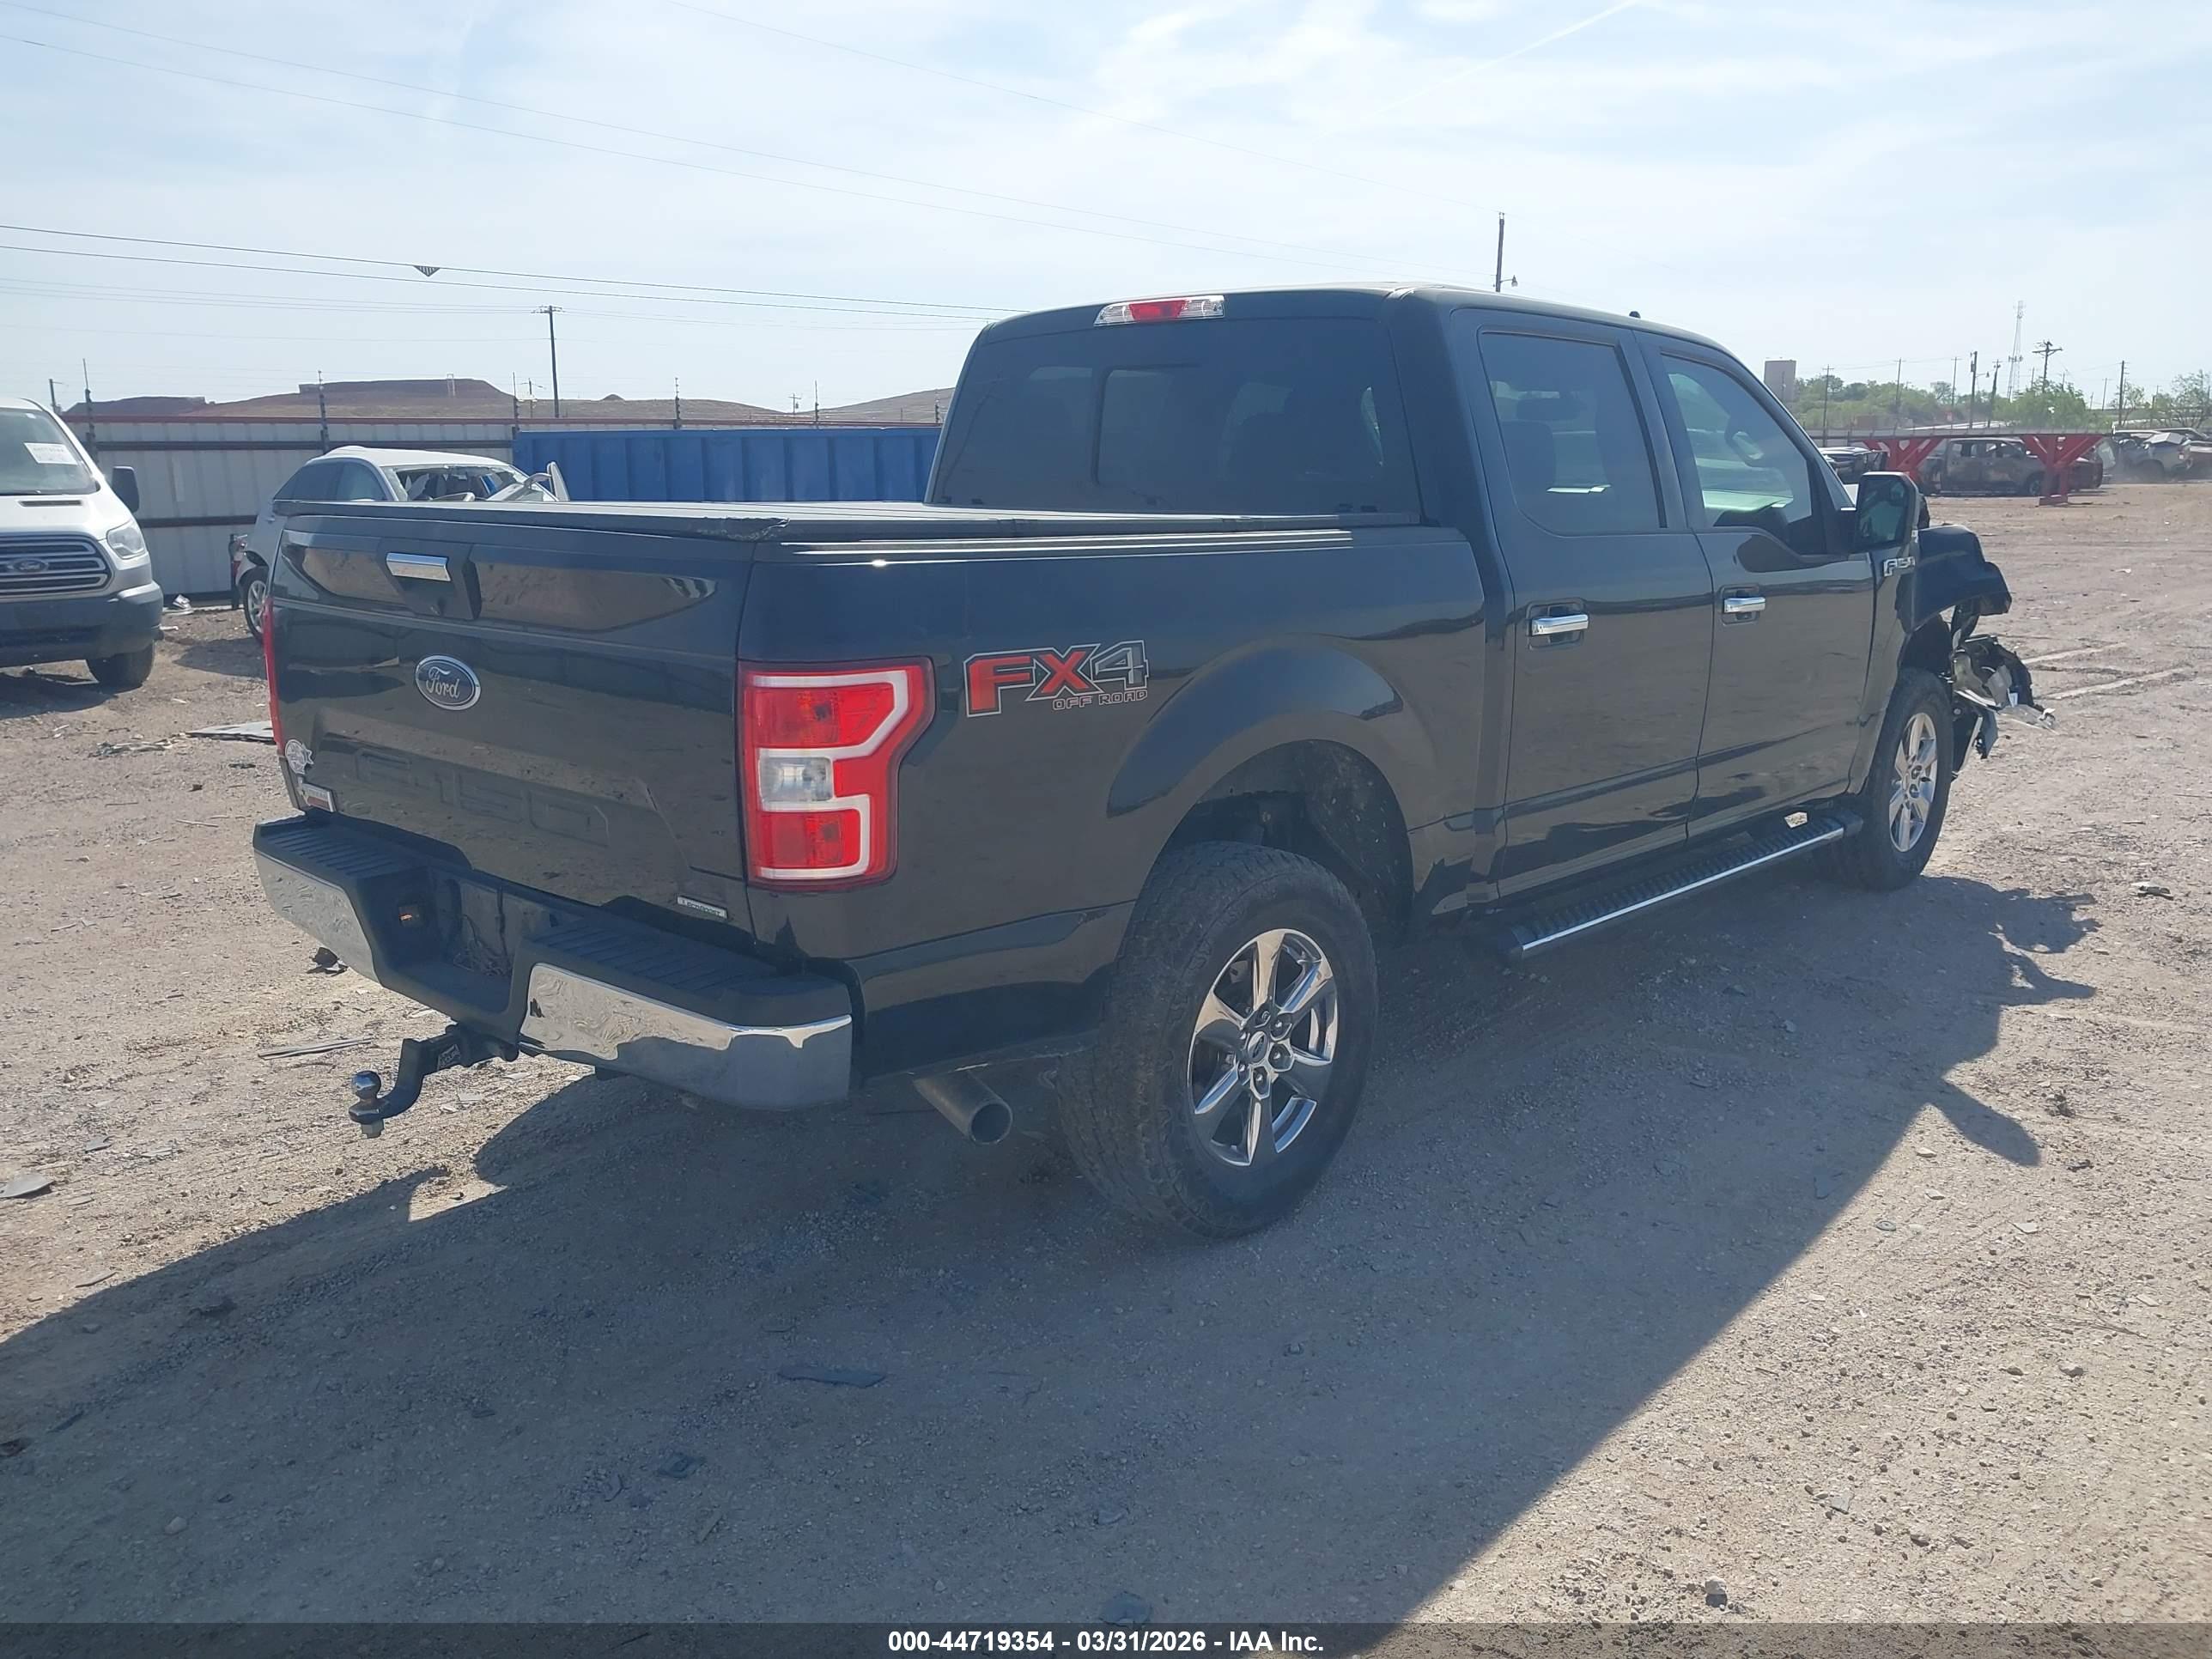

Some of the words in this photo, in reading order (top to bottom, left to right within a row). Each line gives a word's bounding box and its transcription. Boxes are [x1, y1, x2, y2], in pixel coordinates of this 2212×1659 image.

[426, 666, 459, 698] Ford
[963, 640, 1150, 718] FX4
[1052, 696, 1092, 711] OFF
[1098, 690, 1148, 706] ROAD
